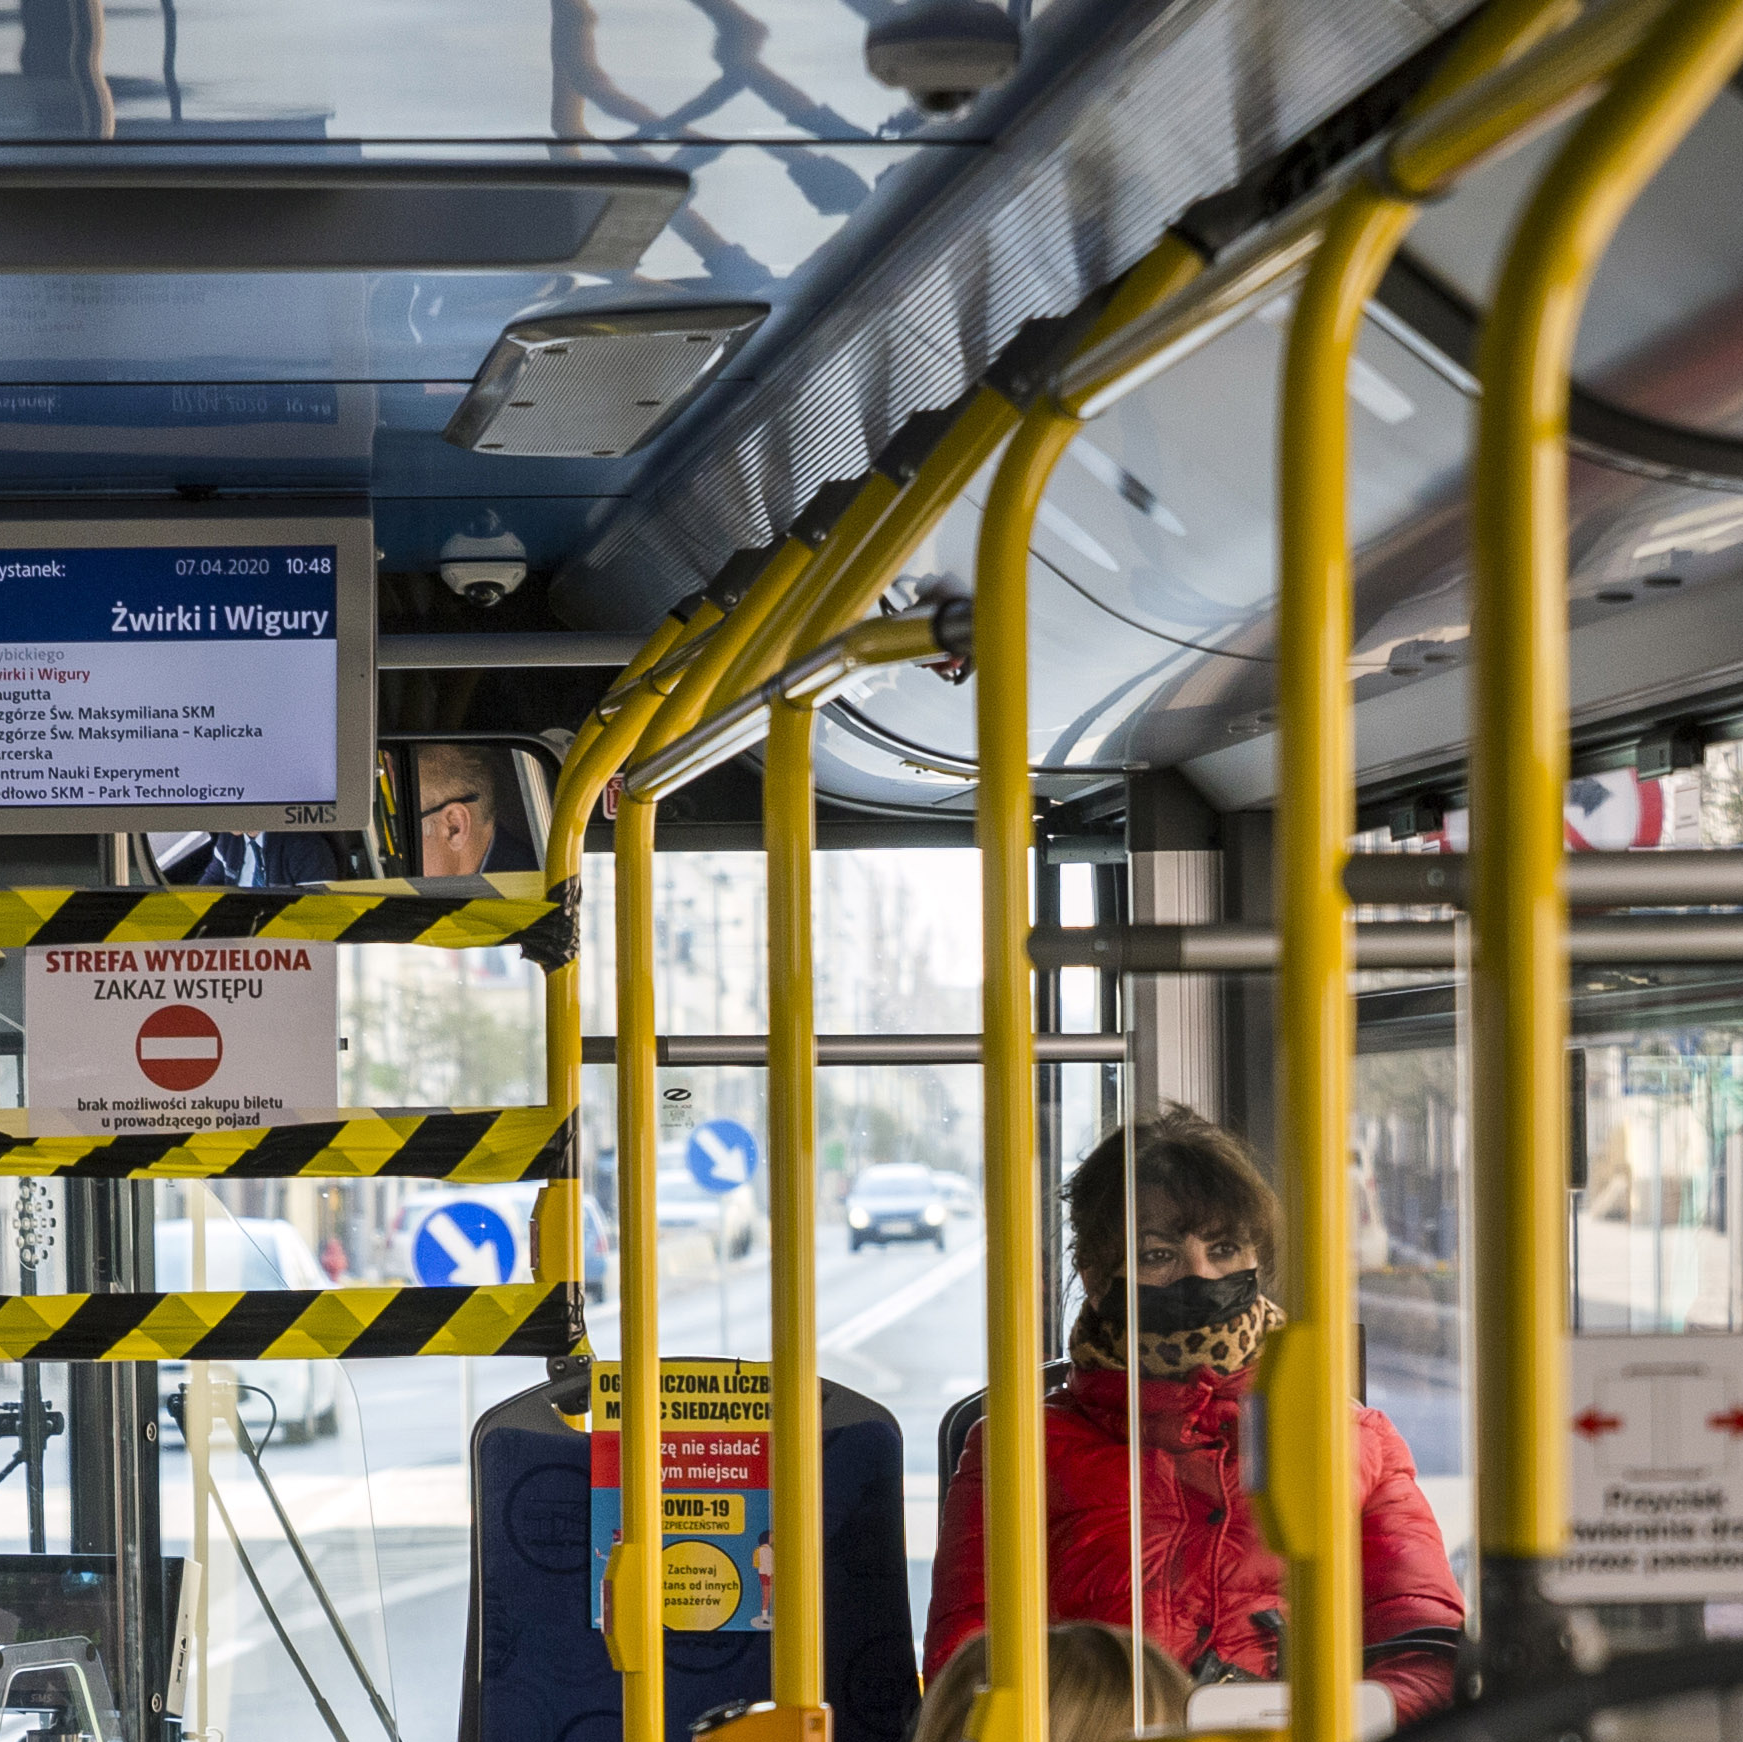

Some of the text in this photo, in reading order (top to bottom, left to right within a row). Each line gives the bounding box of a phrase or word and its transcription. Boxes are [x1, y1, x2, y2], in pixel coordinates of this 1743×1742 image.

[176, 559, 270, 576] 07.04.2020
[286, 558, 331, 574] 10:48
[111, 601, 328, 636] Żwirki i Wigury
[37, 666, 90, 683] Wigury
[50, 704, 74, 720] Św.
[78, 706, 178, 724] Maksymiliana
[182, 706, 215, 719] SKM
[50, 724, 74, 740] Św.
[78, 726, 179, 743] Maksymiliana
[193, 725, 263, 741] Kapliczka
[48, 766, 90, 780] Nauki
[93, 766, 180, 782] Experyment
[51, 786, 84, 799] SKM
[99, 785, 130, 799] Park
[134, 784, 245, 801] Technologiczny
[284, 805, 337, 824] SiMS
[46, 948, 311, 973] STREFA WYDZIELONA
[94, 978, 263, 1003] ZAKAZ WSTĘPU
[77, 1095, 283, 1114] brak możliwości zakupu biletu
[101, 1112, 260, 1131] u prowadzącego pojazd
[724, 1375, 772, 1394] LICZB
[681, 1439, 705, 1455] nie
[709, 1438, 761, 1456] siadać
[661, 1463, 749, 1483] ym miejscu
[662, 1499, 730, 1517] OVID-19
[667, 1563, 717, 1577] Zachowaj
[689, 1580, 702, 1591] od
[705, 1580, 739, 1593] innych
[664, 1595, 721, 1609] pasażerów
